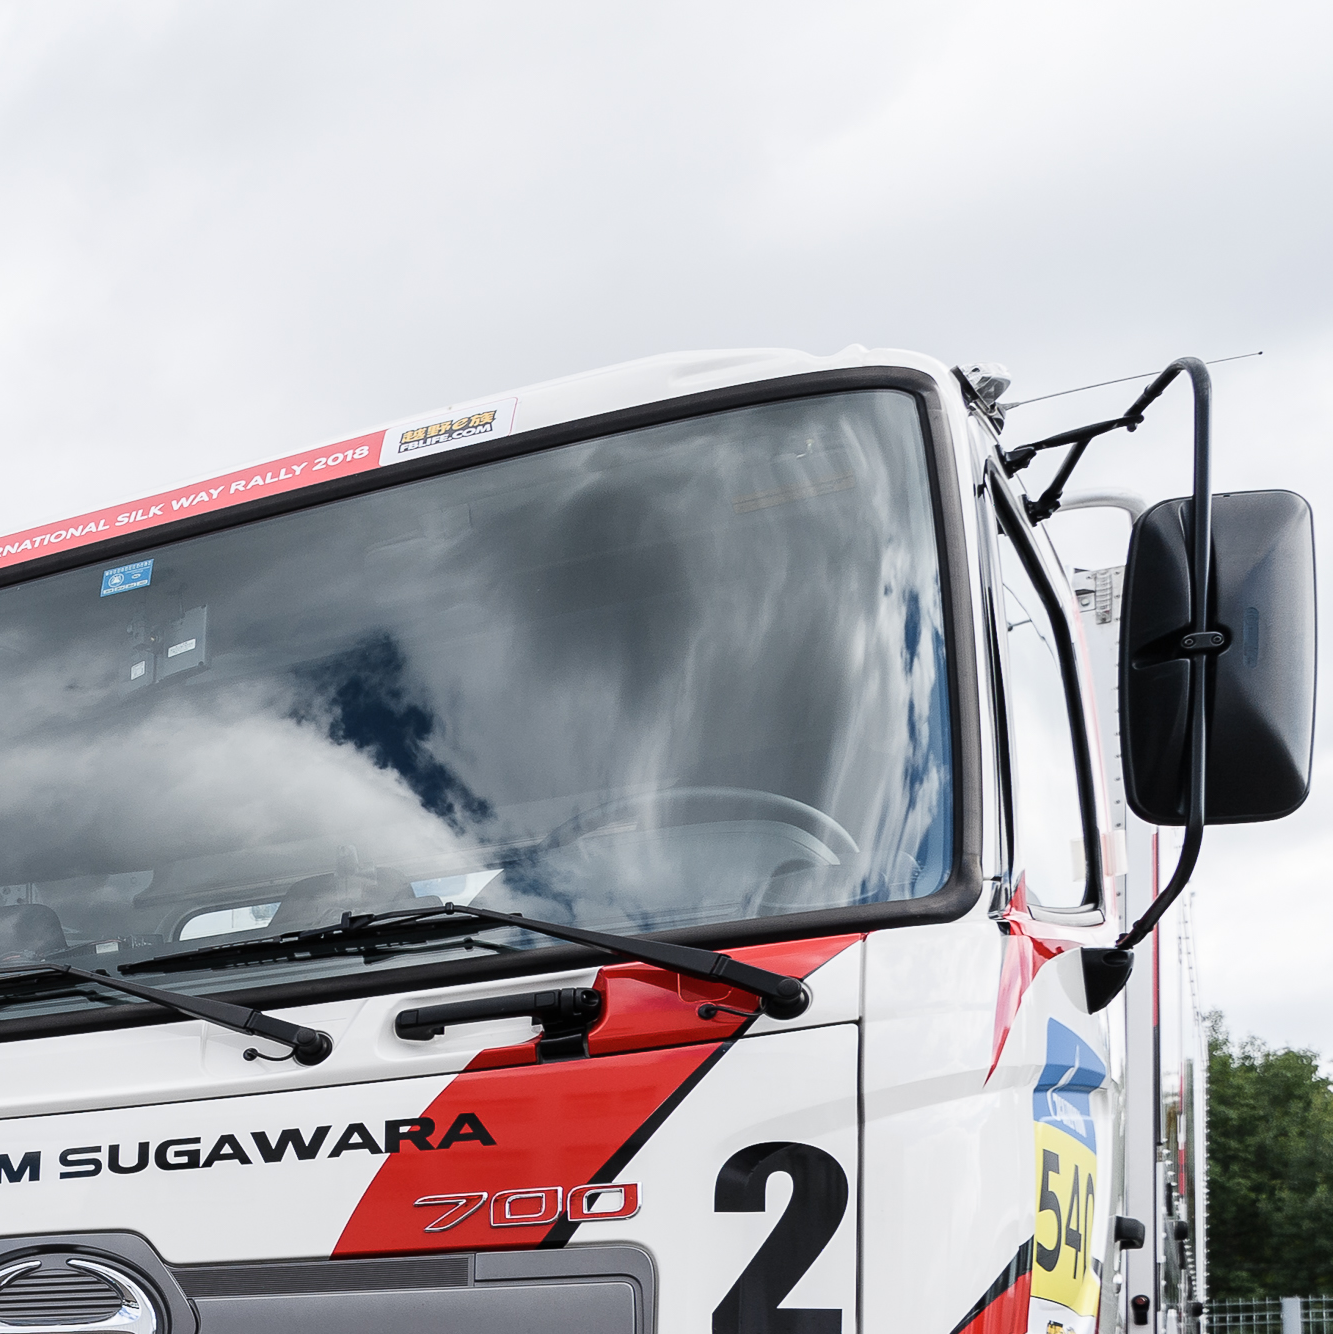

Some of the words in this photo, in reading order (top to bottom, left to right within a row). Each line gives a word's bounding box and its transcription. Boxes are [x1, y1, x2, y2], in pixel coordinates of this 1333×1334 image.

[114, 502, 165, 527] SILK
[170, 484, 225, 511] WAY
[229, 460, 312, 495] RALLY
[312, 445, 370, 472] 2018
[397, 422, 493, 455] FBLIFE.COM
[58, 1110, 497, 1181] SUGAWARA
[411, 1180, 642, 1234] 700
